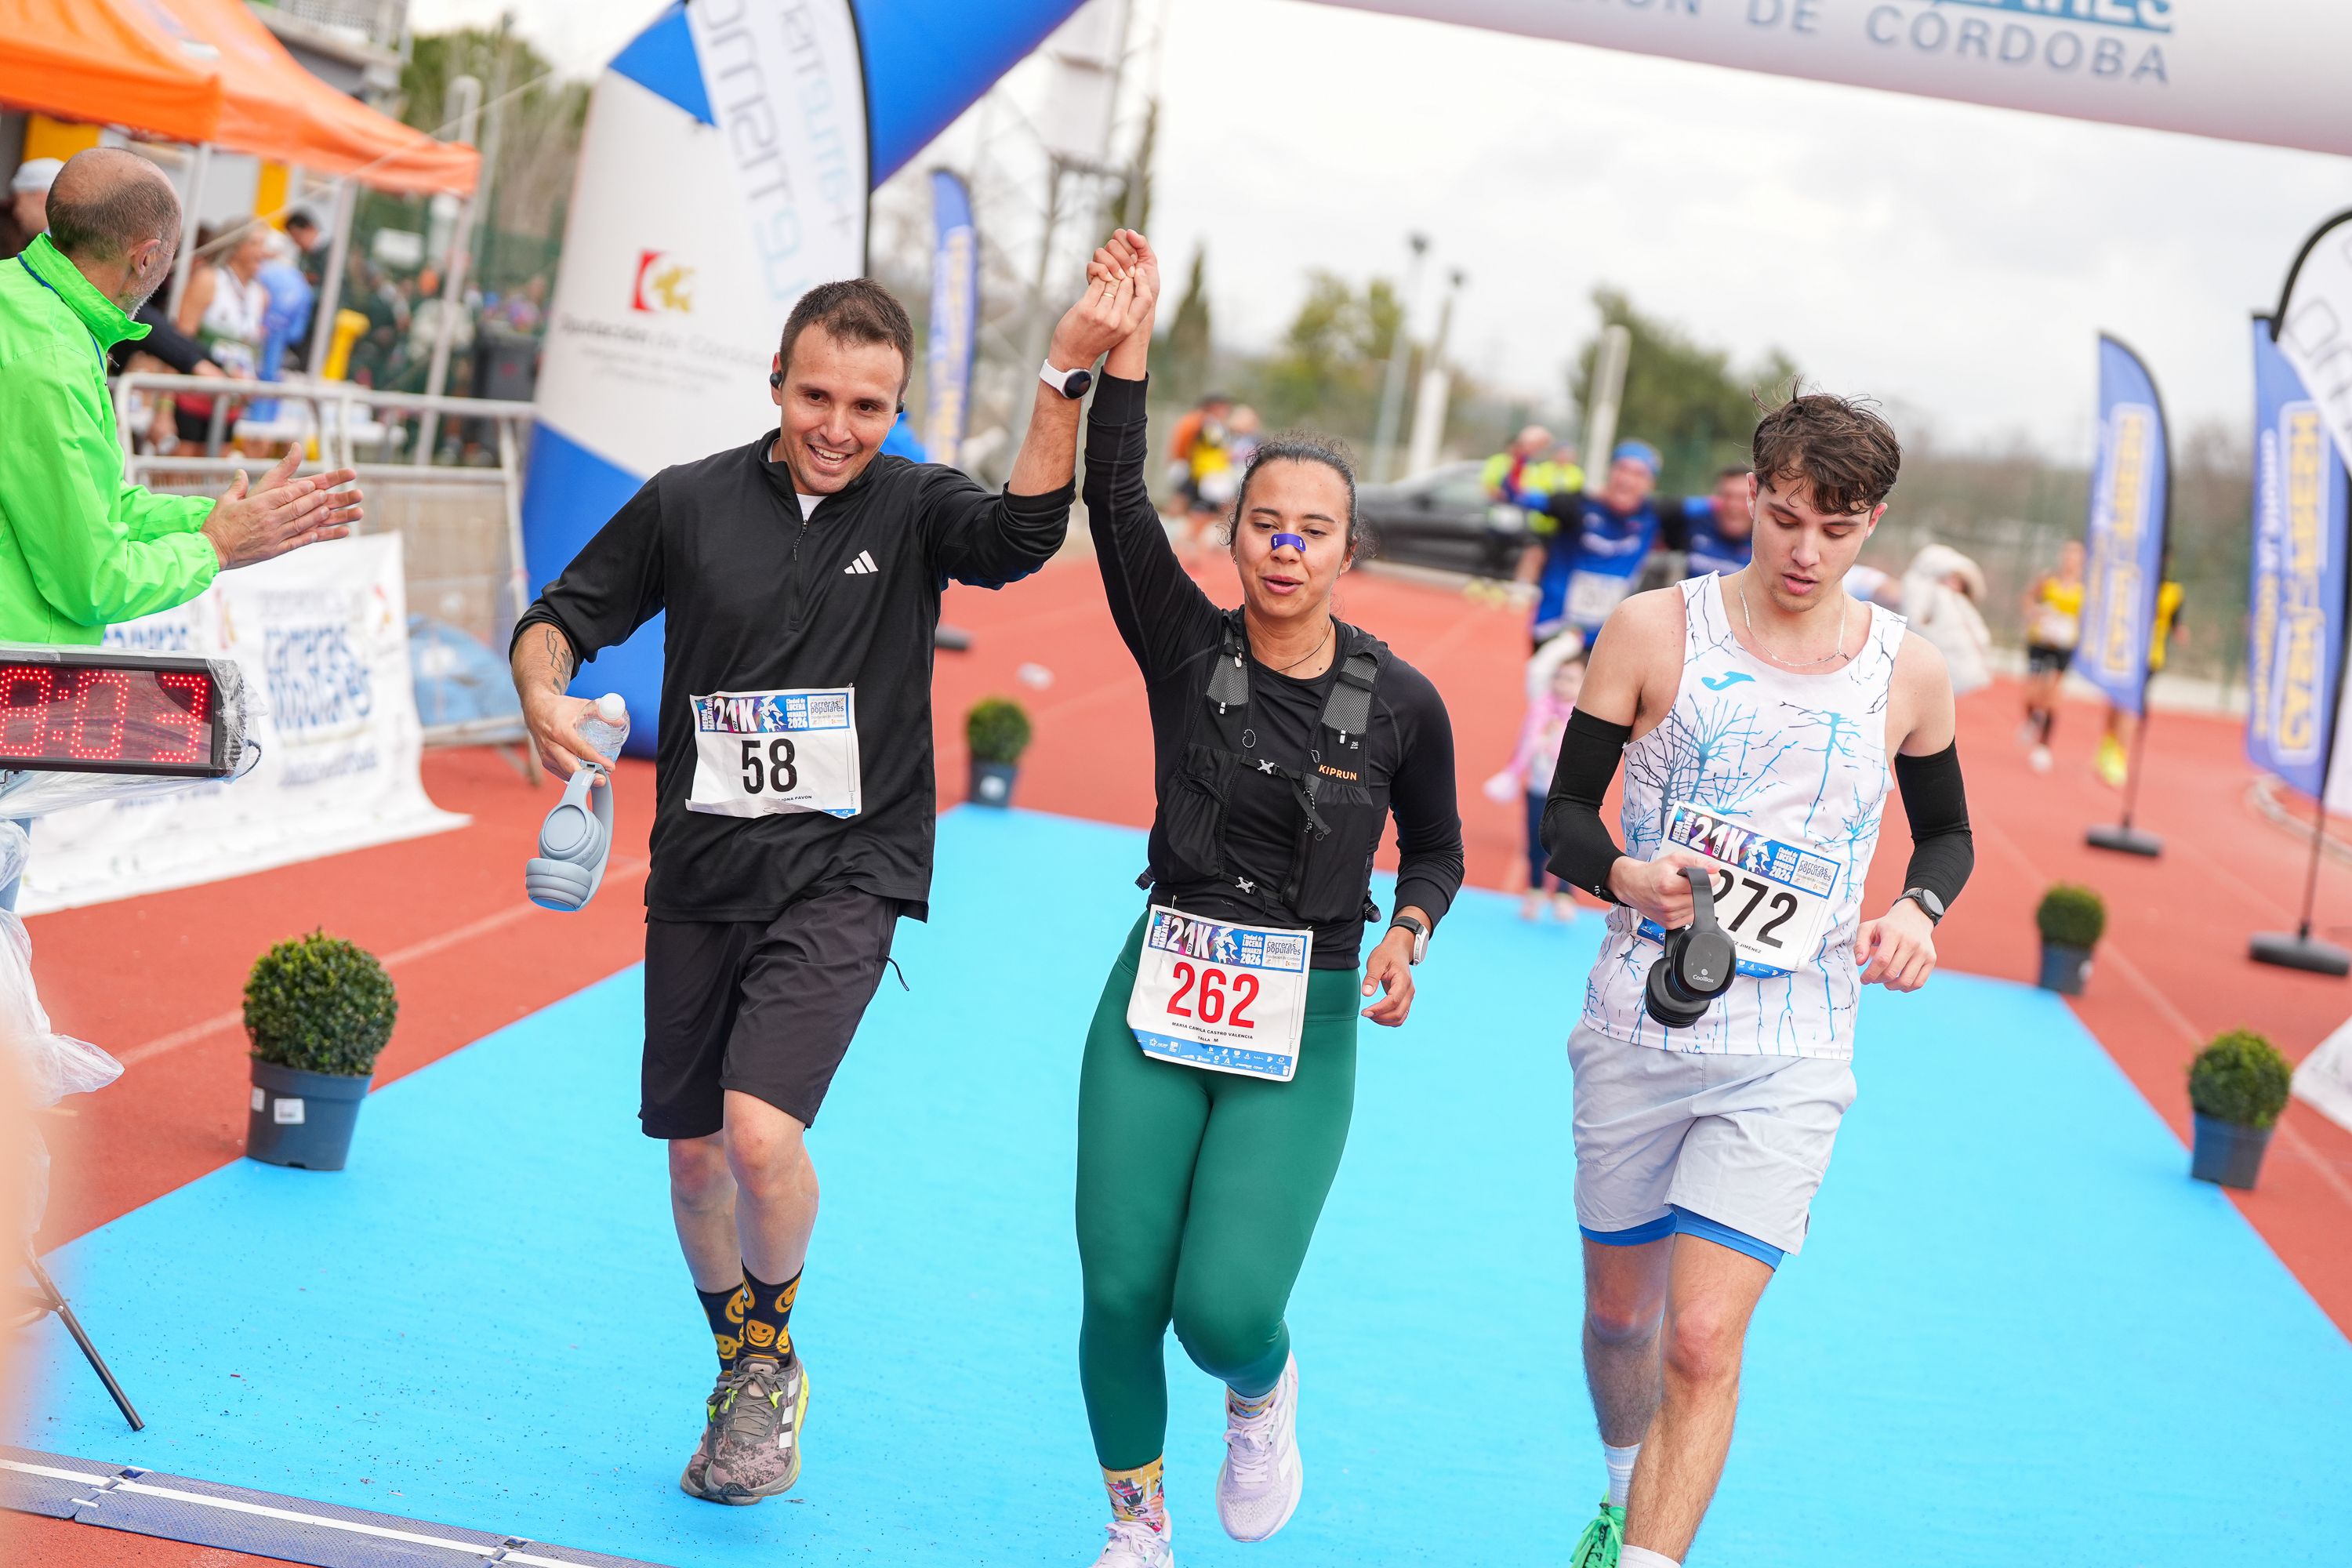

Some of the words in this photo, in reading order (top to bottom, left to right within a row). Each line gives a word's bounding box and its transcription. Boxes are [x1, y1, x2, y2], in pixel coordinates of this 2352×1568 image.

[1745, 0, 1817, 33] DE
[714, 698, 758, 732] 21K
[811, 706, 844, 715] populares
[788, 717, 808, 728] 2026
[742, 739, 797, 794] 58
[1318, 764, 1358, 782] KIPRUN
[1689, 816, 1749, 865] 21K
[1769, 866, 1791, 881] 2026
[1798, 865, 1831, 881] populares
[1800, 860, 1828, 874] carreras
[1166, 917, 1213, 960] 21K
[1267, 941, 1296, 949] carreras
[1266, 946, 1301, 956] populares
[1739, 943, 1762, 953] JIMENEZ
[1240, 953, 1261, 966] 2026
[1693, 974, 1715, 984] CoolBox
[1167, 961, 1259, 1029] 262
